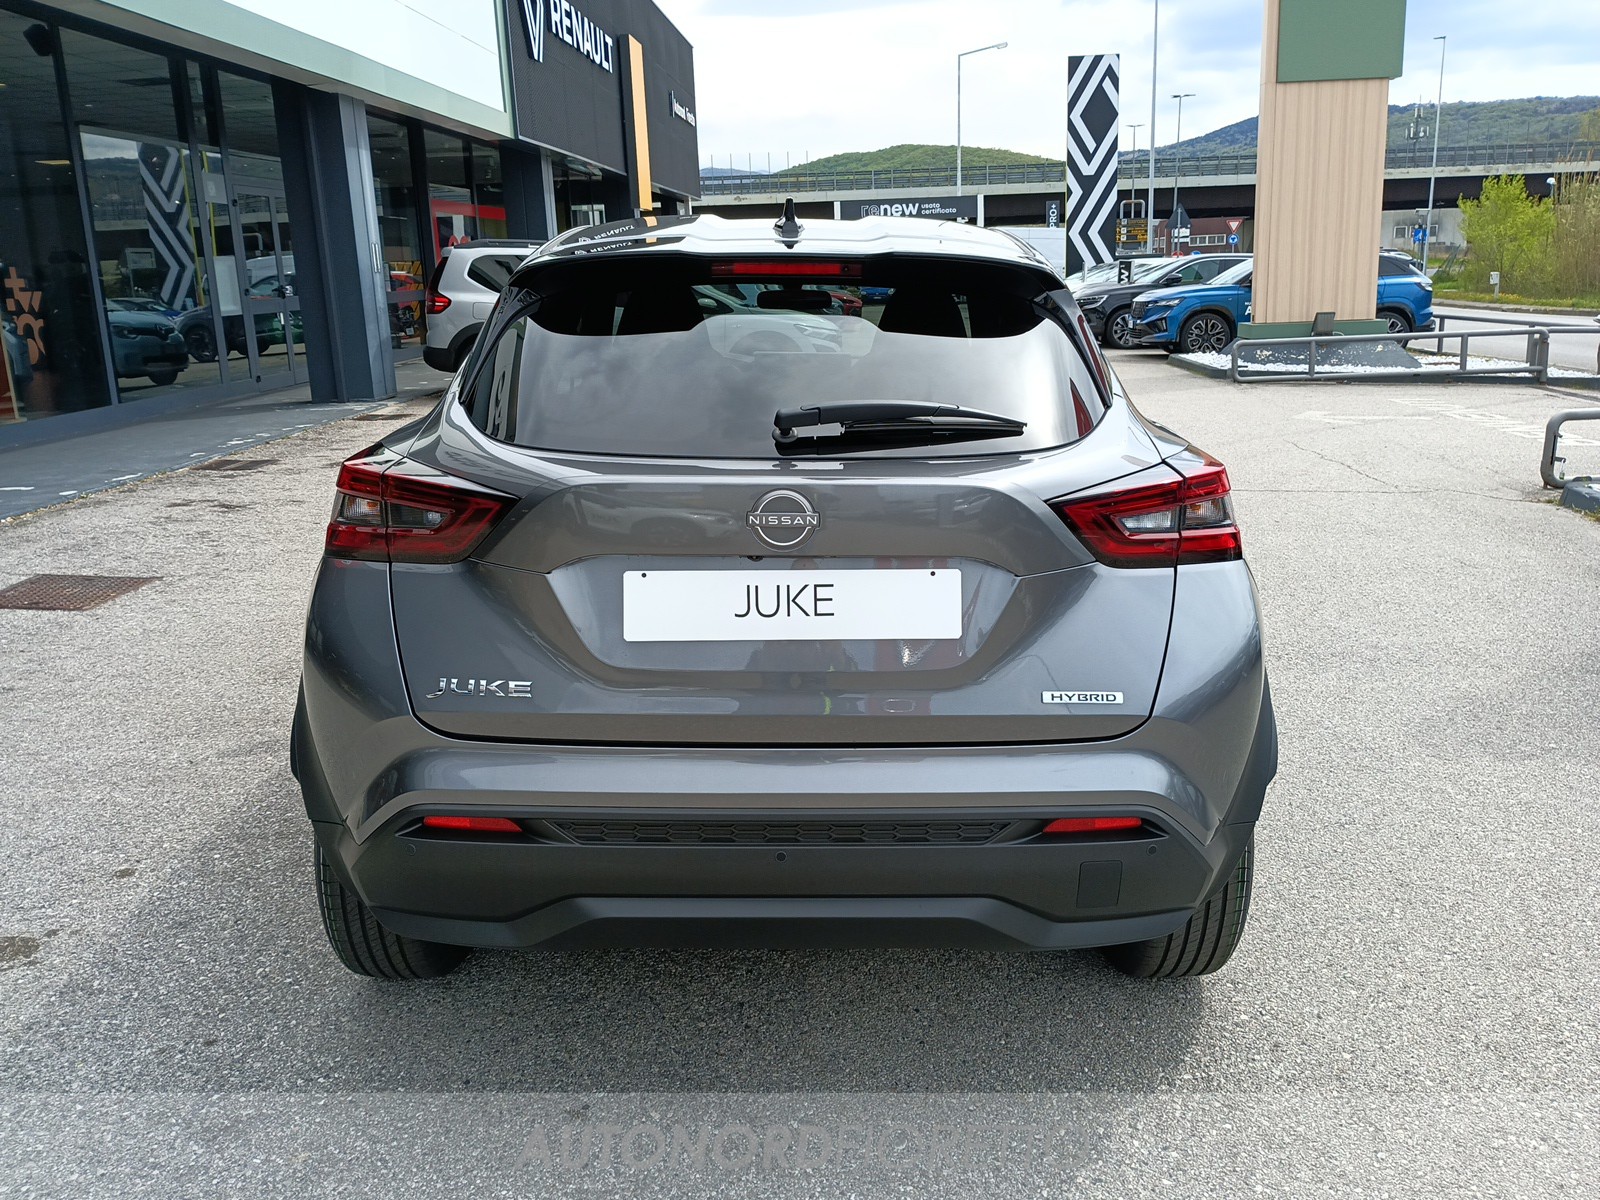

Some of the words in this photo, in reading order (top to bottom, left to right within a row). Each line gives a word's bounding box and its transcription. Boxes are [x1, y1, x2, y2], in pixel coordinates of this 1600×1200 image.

[550, 0, 613, 74] RENAULT
[861, 203, 919, 217] renew
[1049, 203, 1058, 228] PRO+
[749, 515, 818, 526] NISSAN
[734, 583, 835, 618] JUKE
[425, 677, 533, 699] JUKE
[1050, 693, 1117, 702] HYBRID
